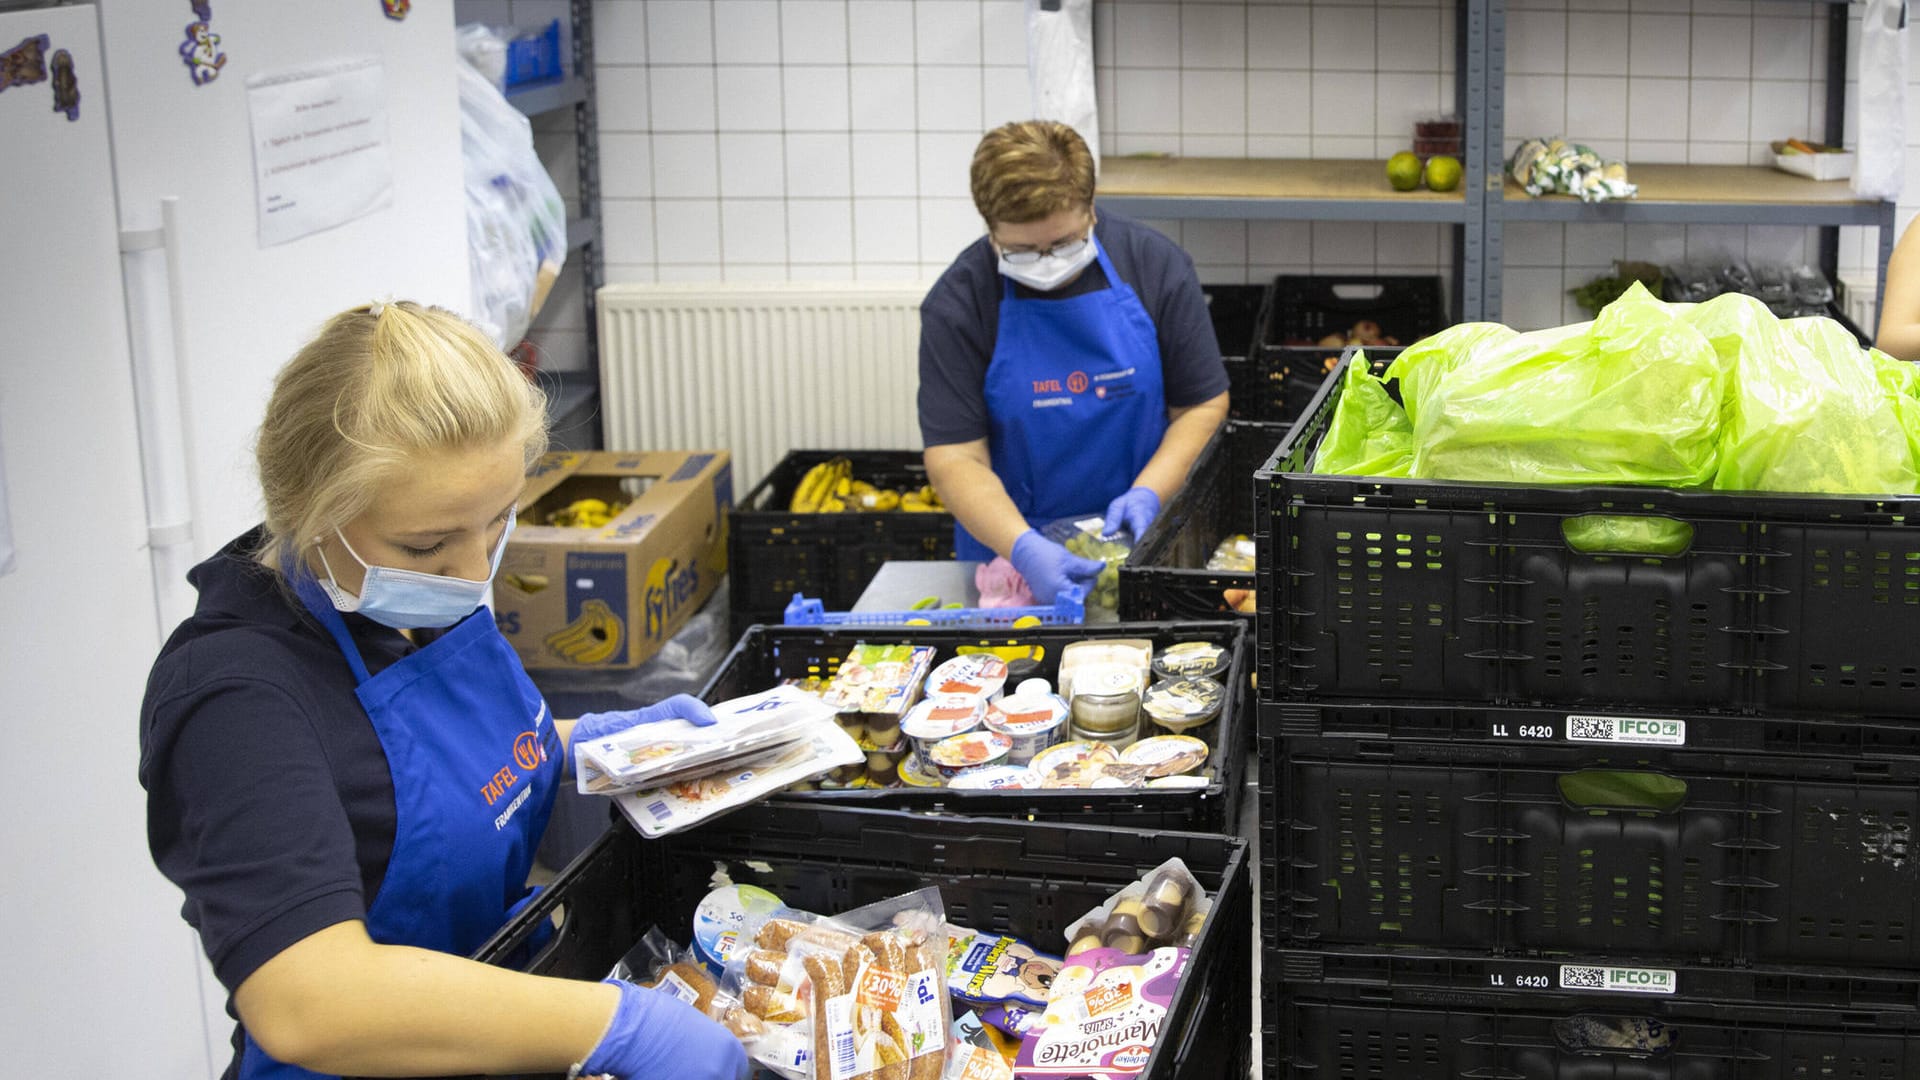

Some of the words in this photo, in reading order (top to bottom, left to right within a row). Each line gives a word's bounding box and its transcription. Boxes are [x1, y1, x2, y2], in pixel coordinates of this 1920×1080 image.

[1033, 380, 1062, 394] TAFEL
[1492, 724, 1509, 737] LL
[1519, 725, 1553, 739] 6420
[1618, 719, 1661, 735] IFCO
[480, 765, 518, 806] TAFEL
[1490, 974, 1505, 986] LL
[1516, 975, 1549, 988] 6420
[1609, 969, 1651, 985] IFCO
[1039, 1017, 1164, 1063] Marmorette
